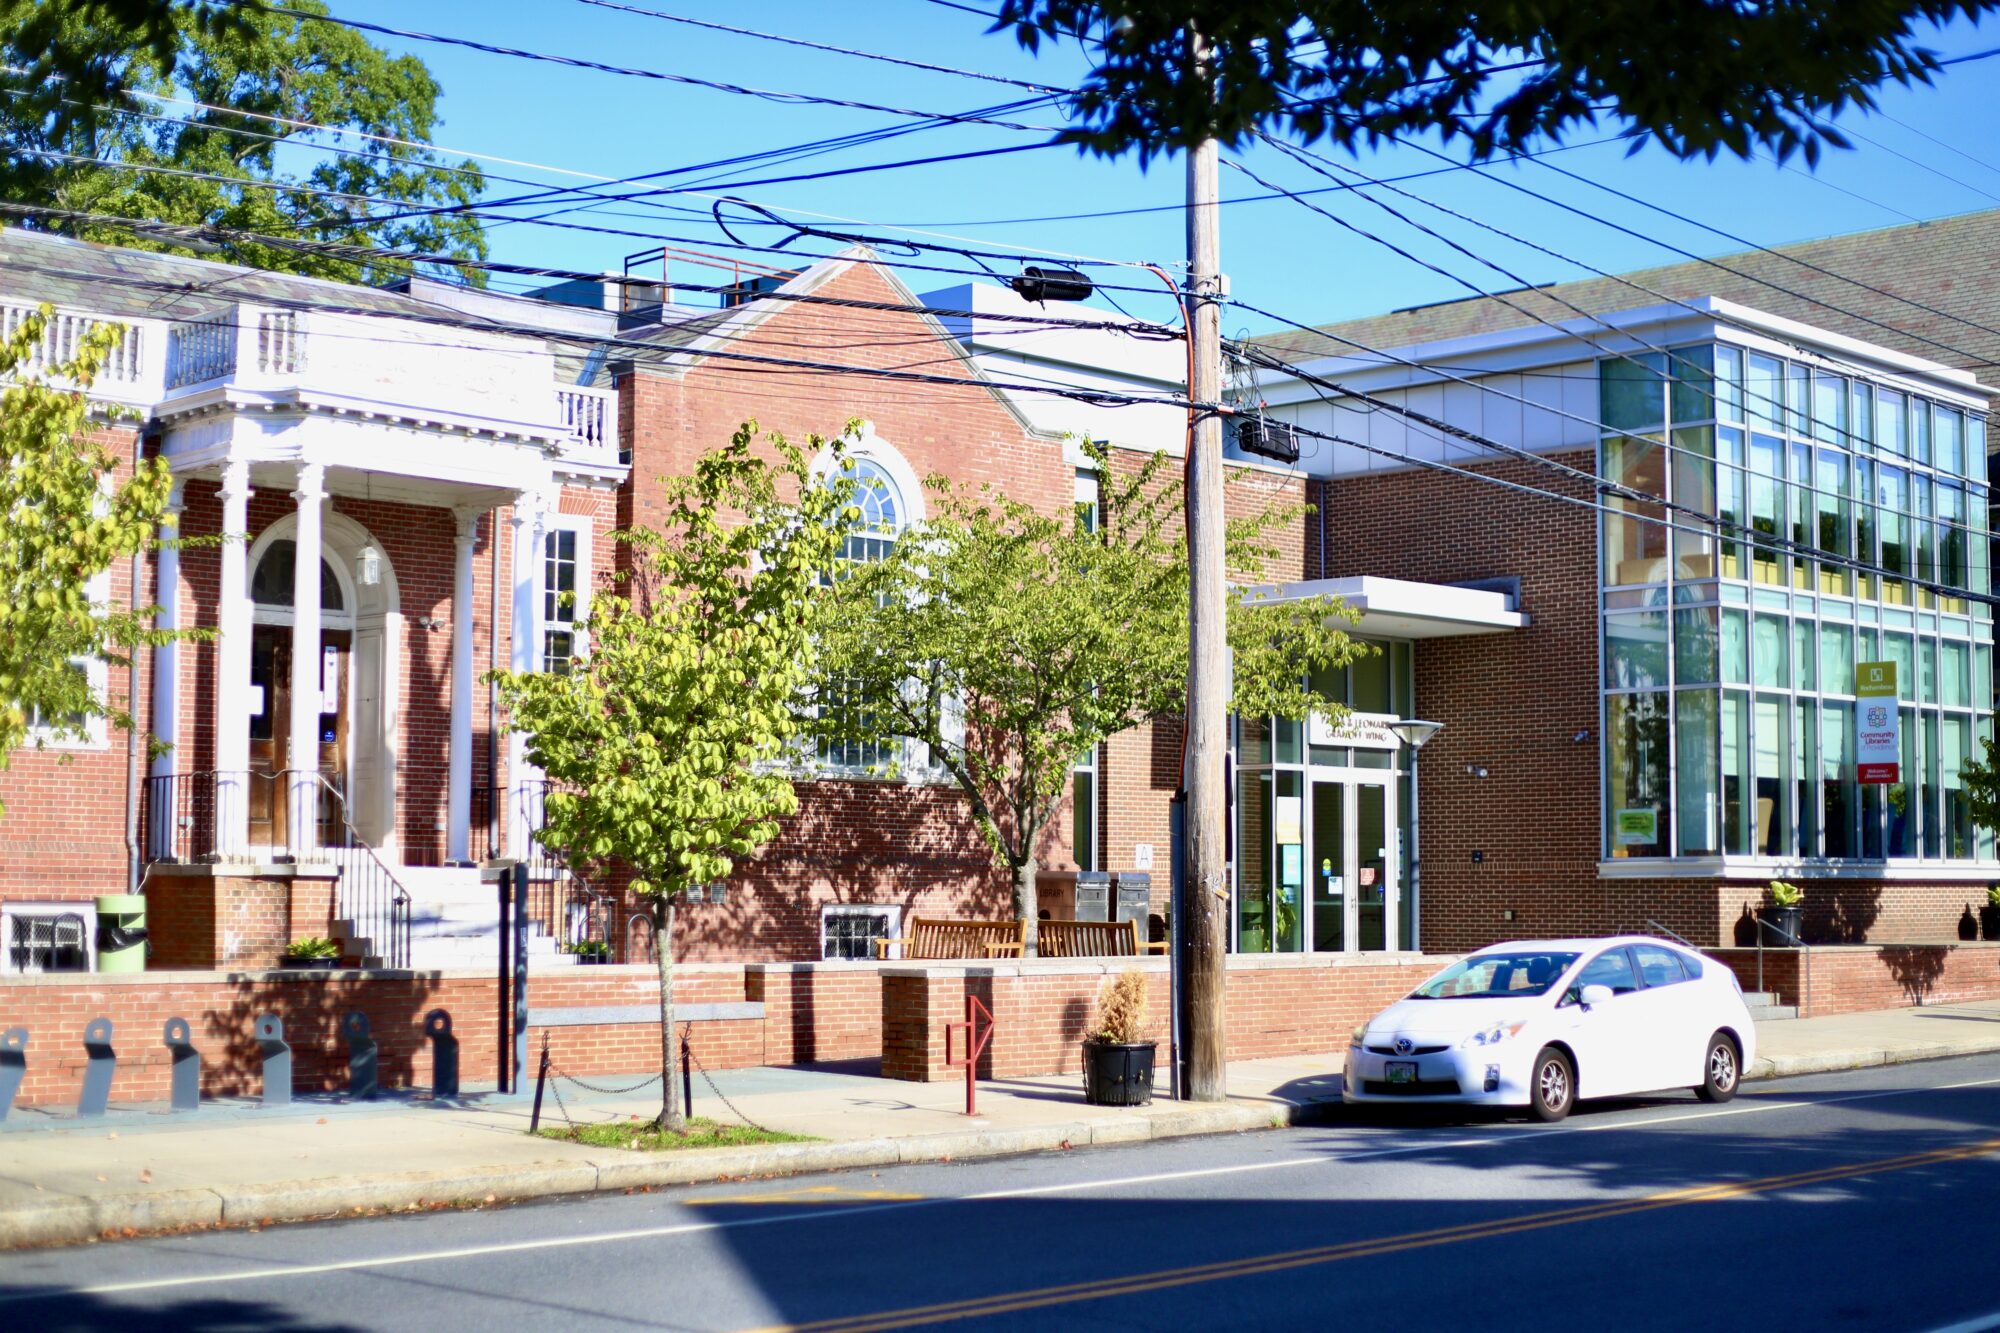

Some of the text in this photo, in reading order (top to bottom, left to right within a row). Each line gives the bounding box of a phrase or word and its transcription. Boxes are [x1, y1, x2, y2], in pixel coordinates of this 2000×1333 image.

[1365, 731, 1387, 741] WING
[1860, 731, 1895, 739] Community
[1040, 888, 1065, 897] LIBRARY
